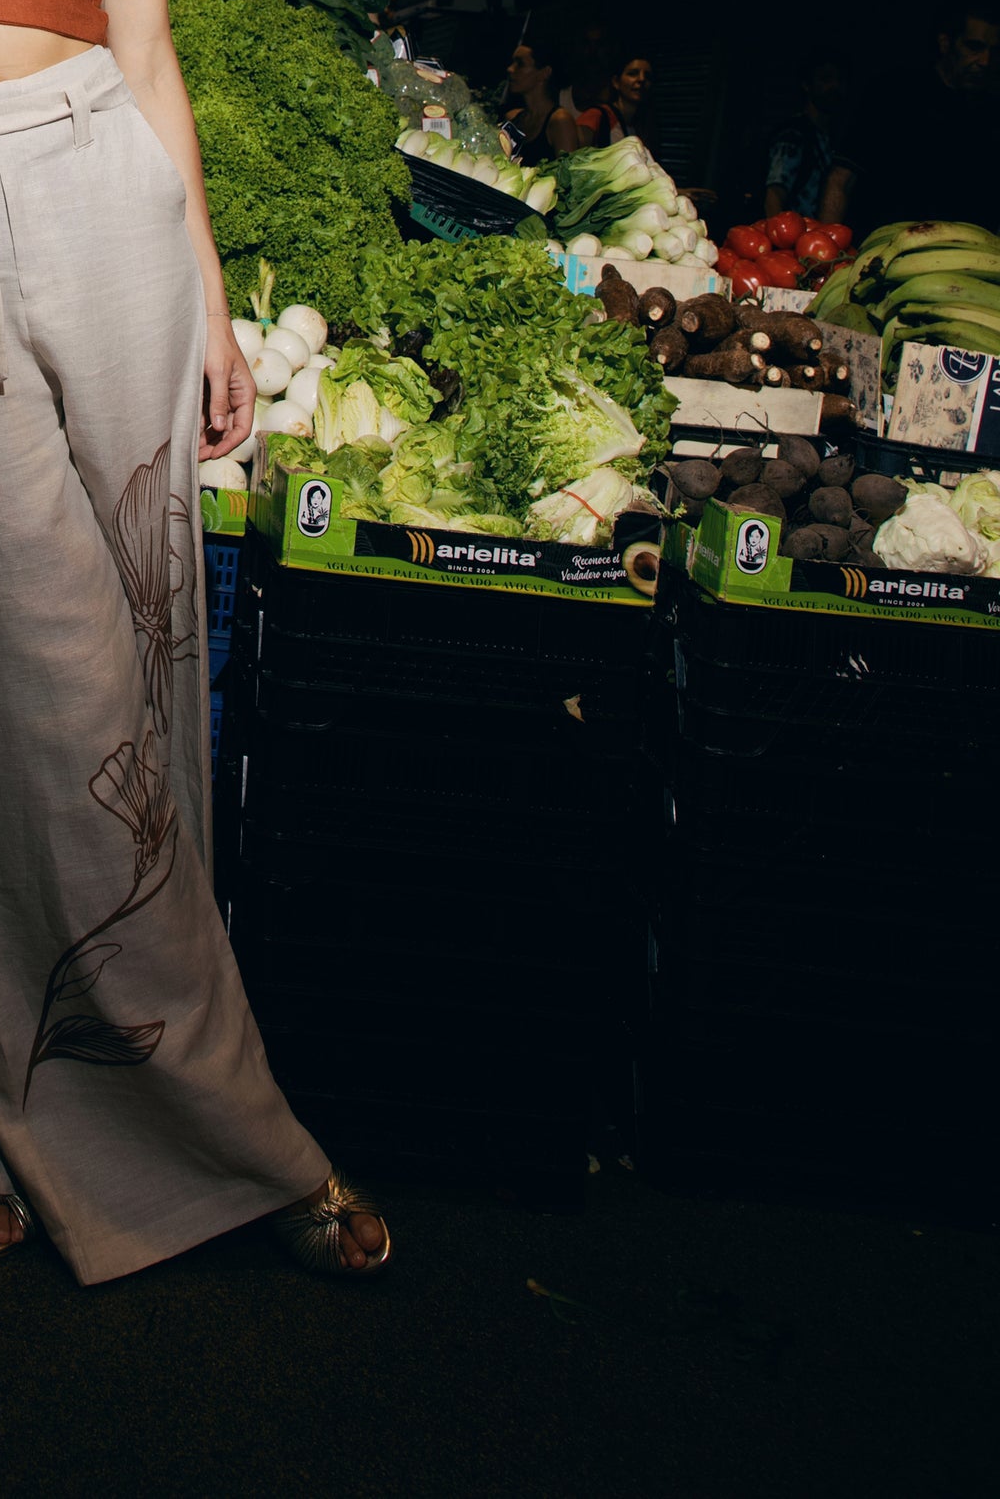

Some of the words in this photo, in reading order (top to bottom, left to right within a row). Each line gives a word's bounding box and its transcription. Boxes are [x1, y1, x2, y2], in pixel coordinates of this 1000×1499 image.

[572, 555, 612, 570] Reconoce
[612, 553, 621, 564] el
[447, 564, 474, 572] SINCE
[476, 567, 496, 575] 2004
[560, 568, 602, 581] Verdadero
[602, 567, 627, 581] origen
[325, 561, 385, 576] AGUACATE
[393, 569, 429, 581] PALTA
[439, 574, 492, 587] AVOCADO
[502, 580, 547, 593] AVOCAT
[555, 587, 615, 600] AGUACATE
[879, 598, 905, 606] SINCE
[761, 597, 818, 610] AGUACATE
[826, 603, 861, 614] PALTA
[870, 607, 921, 620] AVOCADO
[931, 612, 972, 624] AVOCAT
